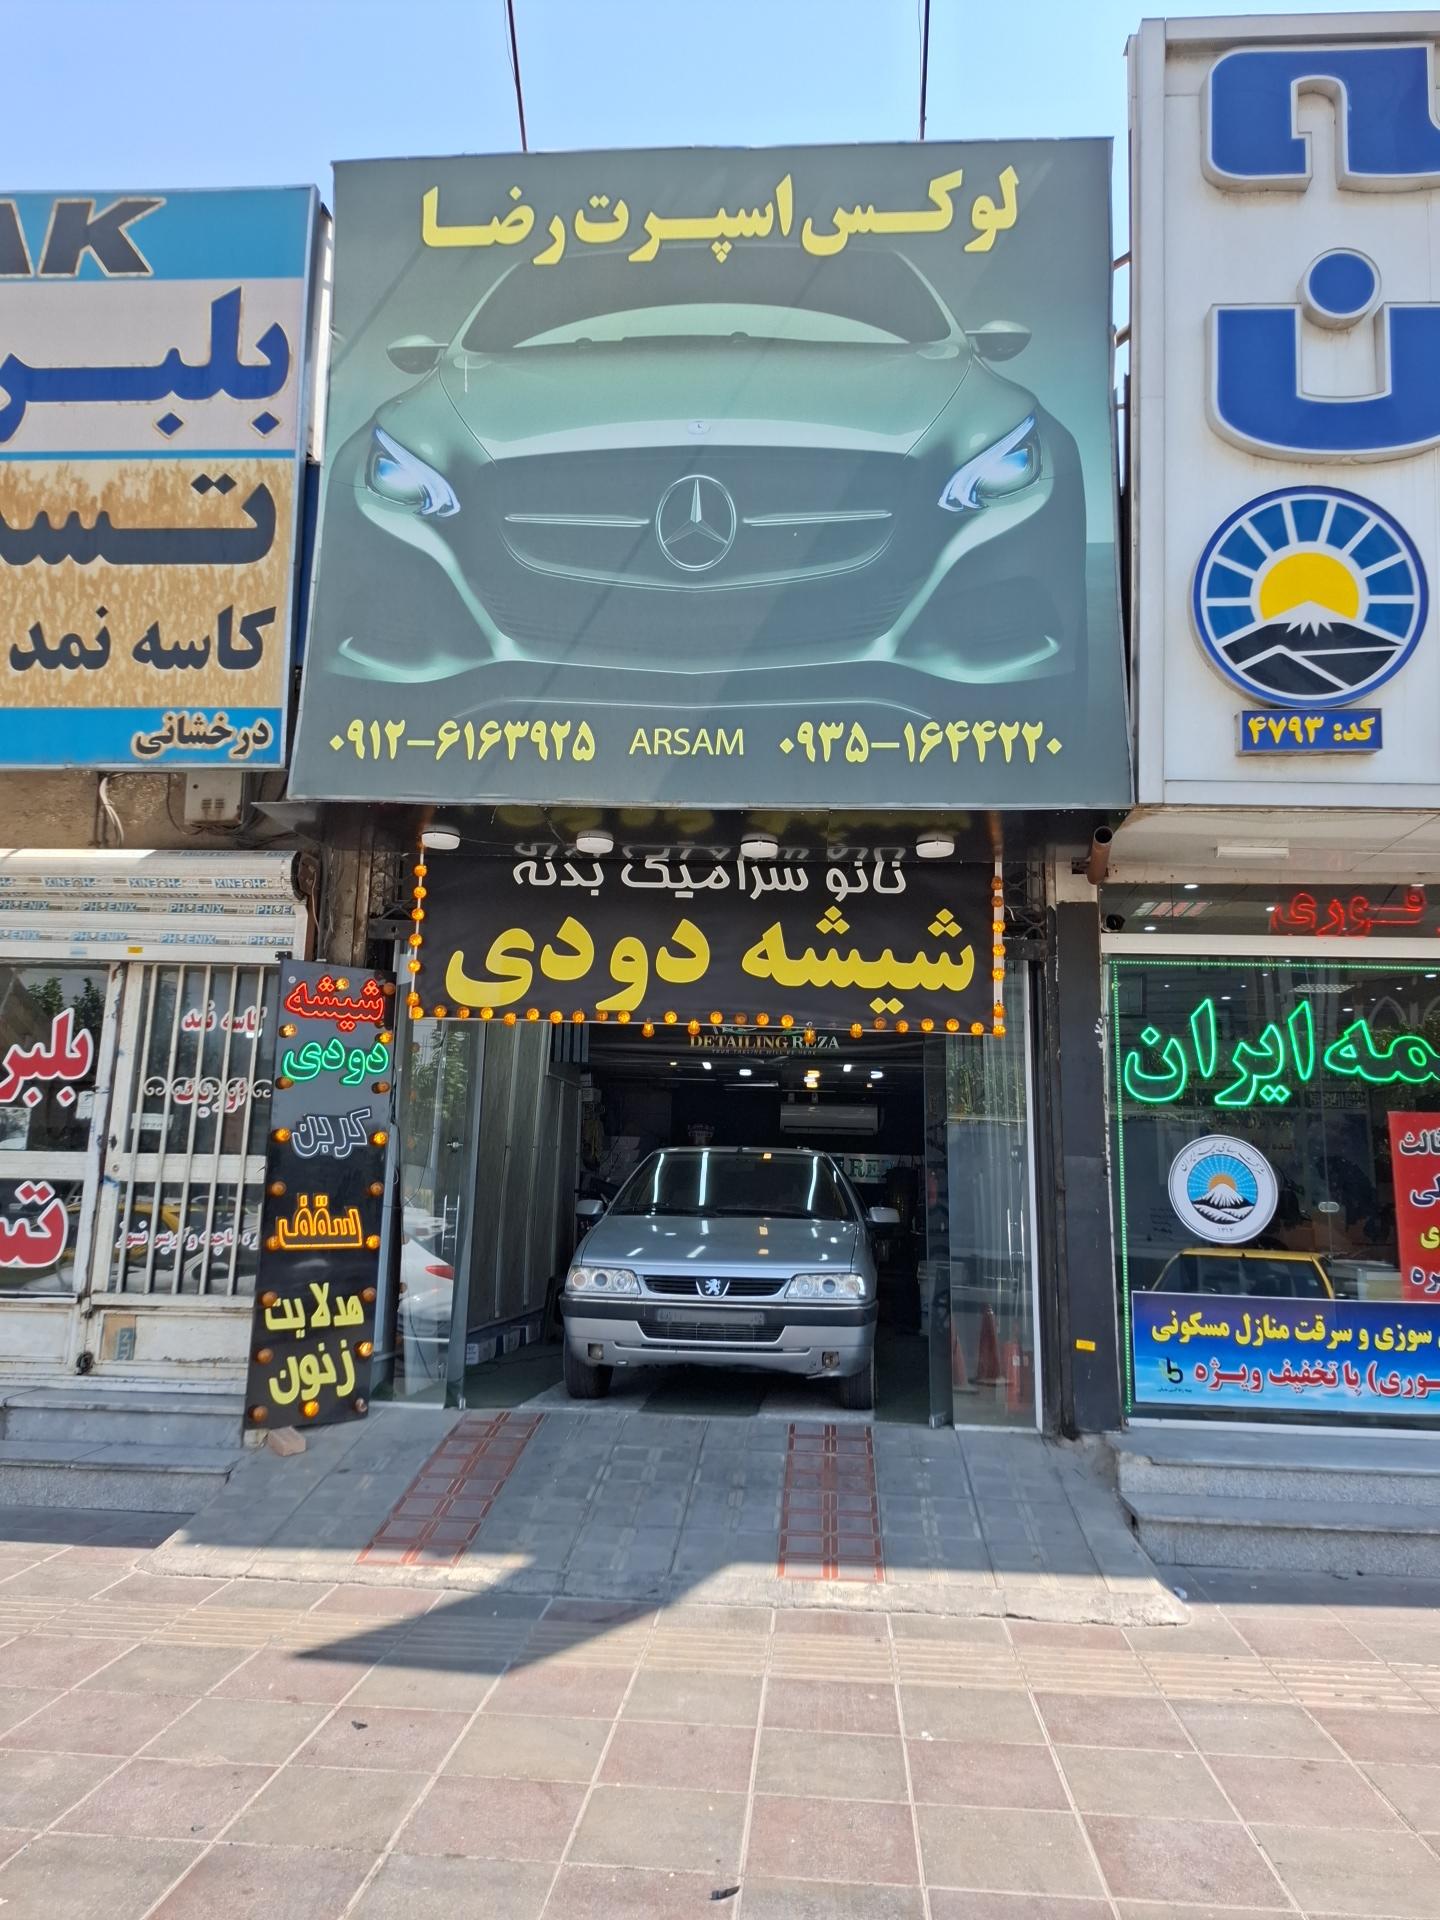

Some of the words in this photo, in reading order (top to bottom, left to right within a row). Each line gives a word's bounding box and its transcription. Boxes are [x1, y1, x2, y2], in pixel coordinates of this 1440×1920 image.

[421, 185, 566, 265] رضا
[574, 173, 794, 264] اسپرت
[802, 165, 1020, 256] لوکس
[9, 605, 111, 672] نمد
[132, 604, 277, 671] کاسه
[133, 713, 272, 758] درخشانی
[629, 728, 745, 756] ARSAM
[1248, 715, 1325, 745] ۴۷۹۳
[1333, 716, 1376, 742] کد:
[512, 856, 605, 896] بدنه
[620, 858, 809, 900] سرامیک
[826, 861, 906, 902] نانو
[168, 903, 224, 914] PHOENIX
[445, 916, 711, 1011] دودی
[741, 905, 976, 1015] شیشه
[286, 976, 384, 1031] شیشه
[283, 1038, 389, 1086] دودی
[689, 1035, 789, 1049] DETAILING
[1123, 998, 1315, 1106] ایران
[292, 1107, 371, 1158] کربن
[1151, 1309, 1231, 1343] مسکونی
[1234, 1312, 1290, 1346] منازل
[1294, 1314, 1354, 1350] سرقت
[1357, 1328, 1370, 1351] و
[1374, 1323, 1433, 1352] سوزی
[268, 1339, 356, 1405] زنون
[1193, 1356, 1264, 1394] ویژه
[1267, 1358, 1340, 1393] تخفیف
[1342, 1360, 1361, 1396] با
